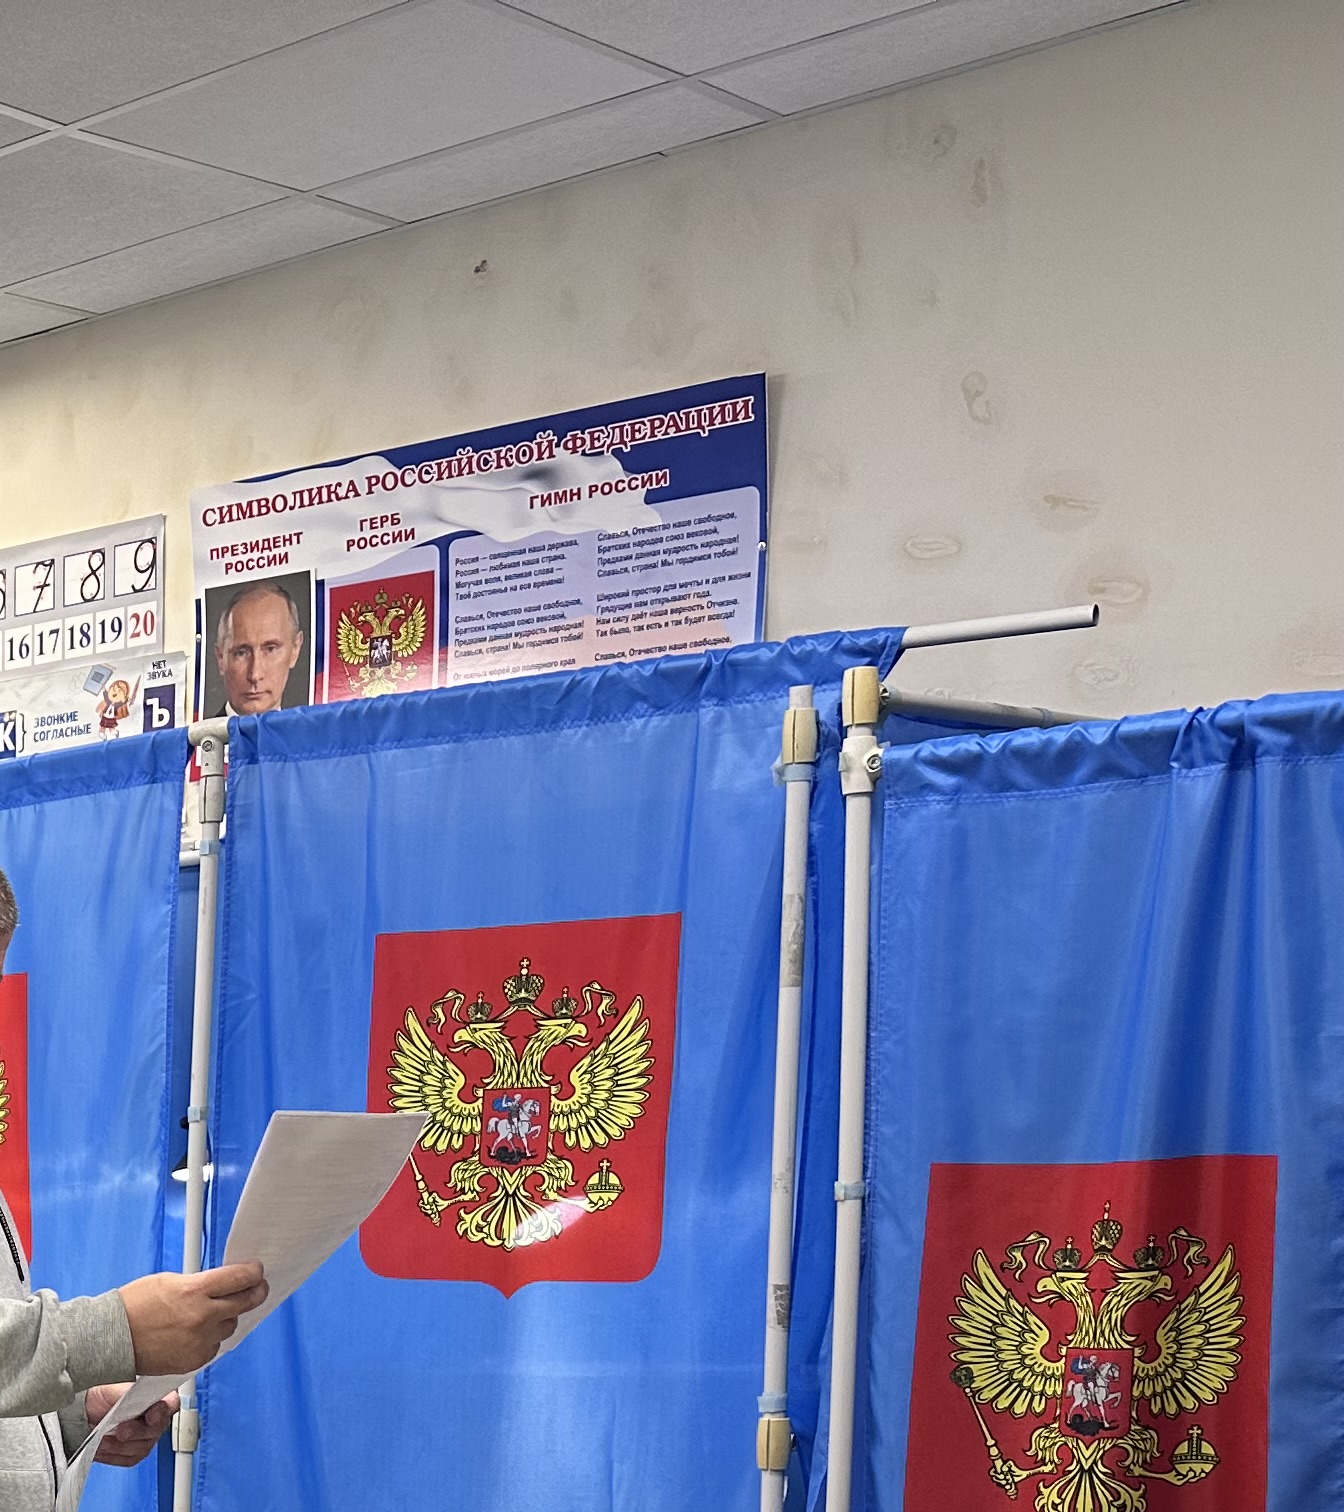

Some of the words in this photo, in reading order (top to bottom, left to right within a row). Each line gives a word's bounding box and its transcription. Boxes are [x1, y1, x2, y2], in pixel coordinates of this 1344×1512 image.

[202, 480, 361, 527] СИМВОЛИКА
[365, 431, 556, 495] РОССИЙСКОЙ
[562, 397, 754, 454] ФЕДЕРАЦИИ
[529, 487, 582, 510] ГИМН
[588, 470, 670, 499] РОССИИ
[359, 512, 402, 532] ГЕРБ
[209, 531, 303, 560] ПРЕЗИДЕНТ
[346, 528, 416, 552] РОССИИ
[33, 559, 55, 613] 7
[80, 550, 105, 602] 8
[131, 538, 157, 593] 9
[225, 552, 288, 575] РОССИИ
[8, 633, 30, 662] 16
[37, 628, 60, 656] 17
[67, 622, 91, 651] 18
[98, 616, 123, 644] 19
[129, 609, 155, 639] 20
[152, 659, 167, 670] НЕТ
[34, 711, 79, 729] ЗВОНКИЕ
[146, 697, 170, 729] Ъ
[33, 723, 92, 743] СОГЛАСНЫЕ
